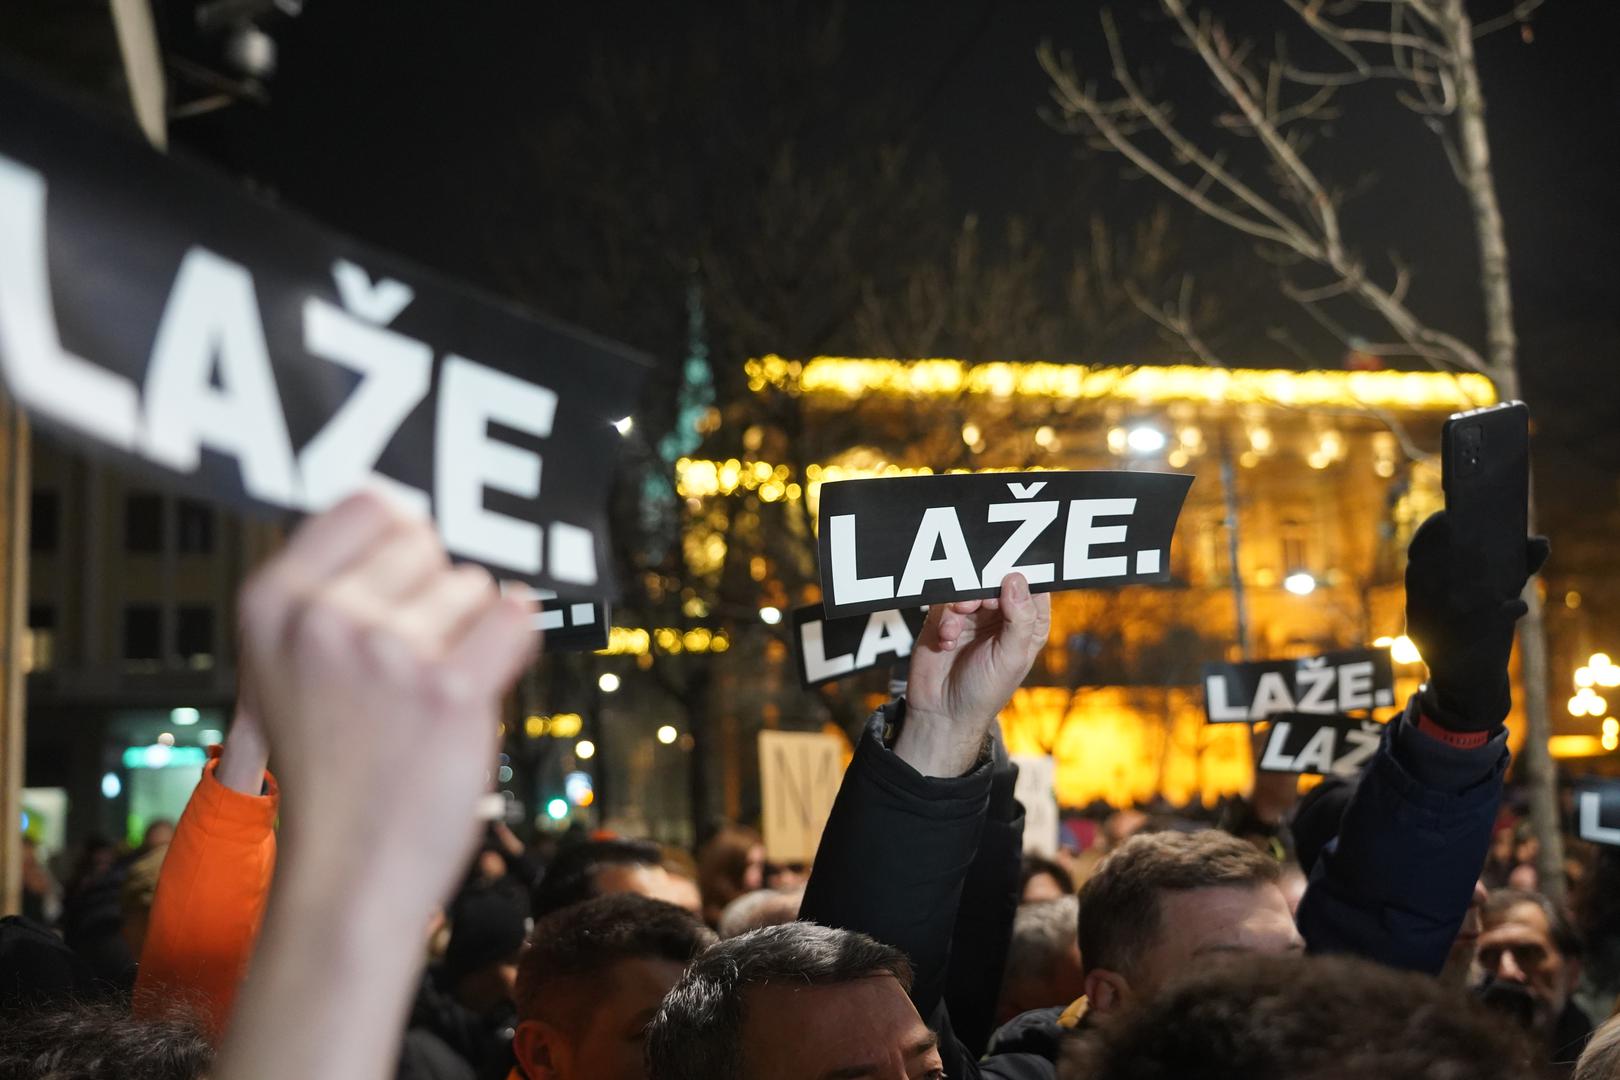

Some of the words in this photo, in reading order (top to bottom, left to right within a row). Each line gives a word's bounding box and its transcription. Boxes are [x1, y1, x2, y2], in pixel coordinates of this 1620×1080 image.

[0, 153, 599, 585] LAŽE.
[830, 482, 1160, 606] LAŽE.
[801, 605, 929, 684] LA
[1206, 657, 1393, 722] LAŽE.
